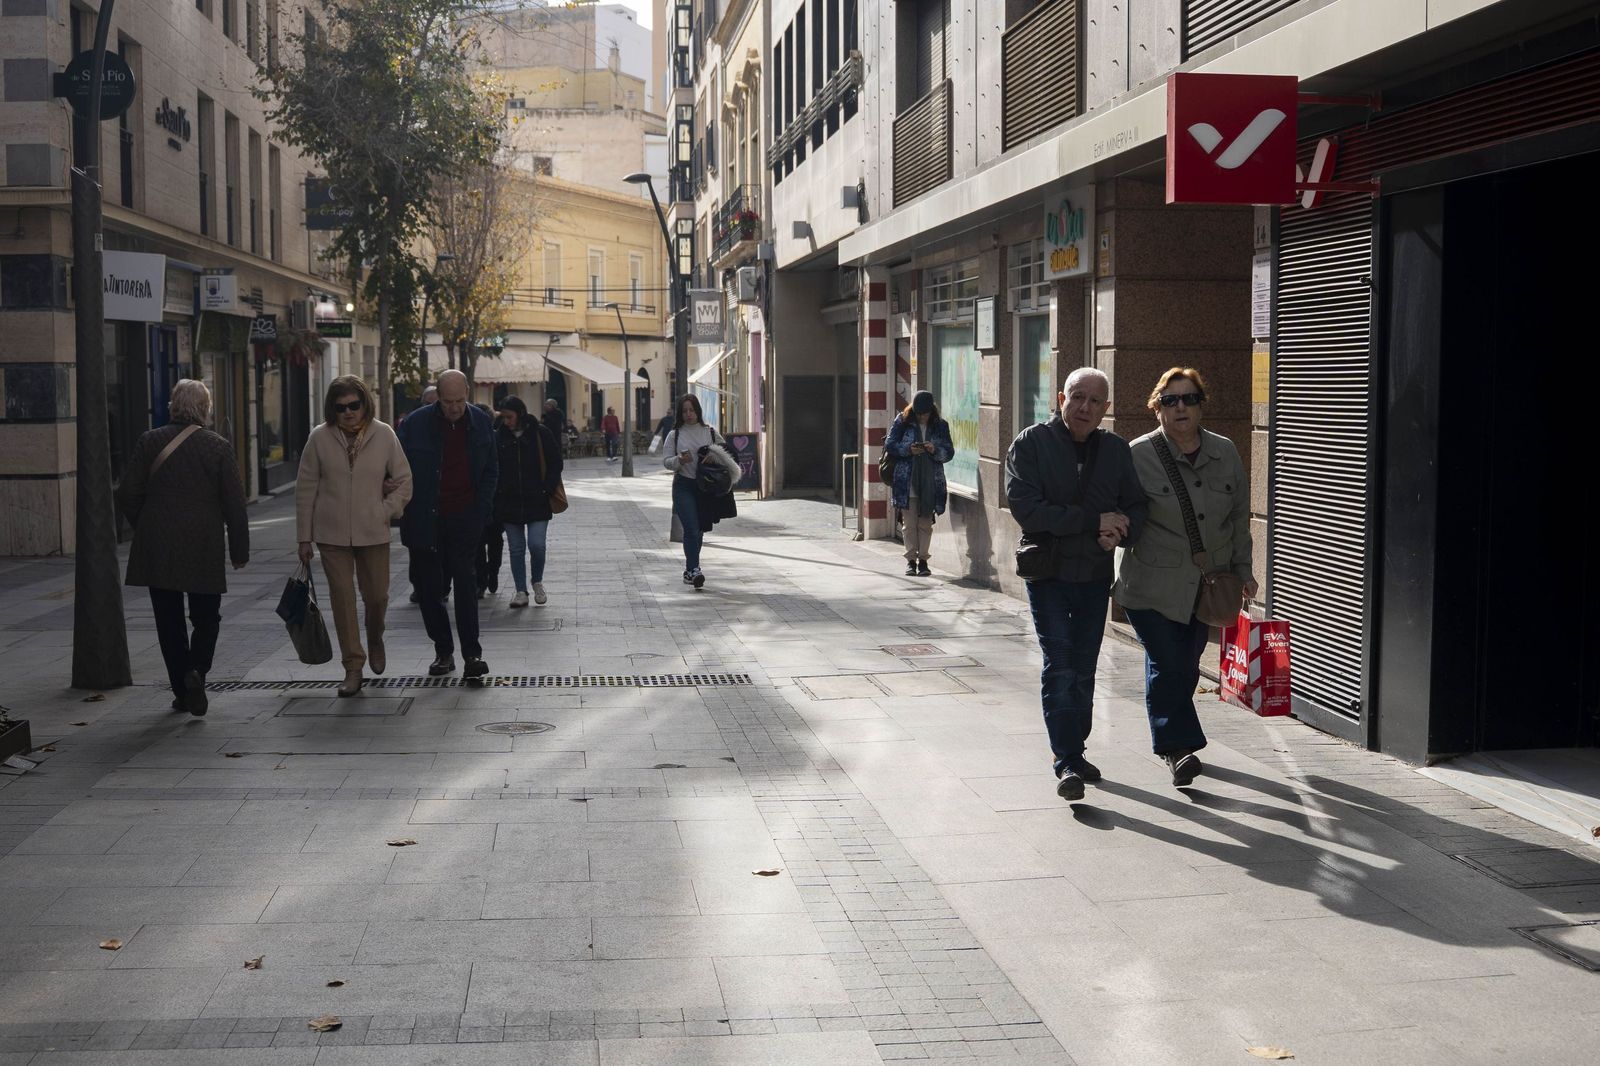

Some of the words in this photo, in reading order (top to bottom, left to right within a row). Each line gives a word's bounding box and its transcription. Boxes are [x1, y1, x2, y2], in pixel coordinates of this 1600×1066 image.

[1107, 130, 1133, 152] MINERVA
[1264, 633, 1286, 641] EVA
[1226, 643, 1247, 667] EVA
